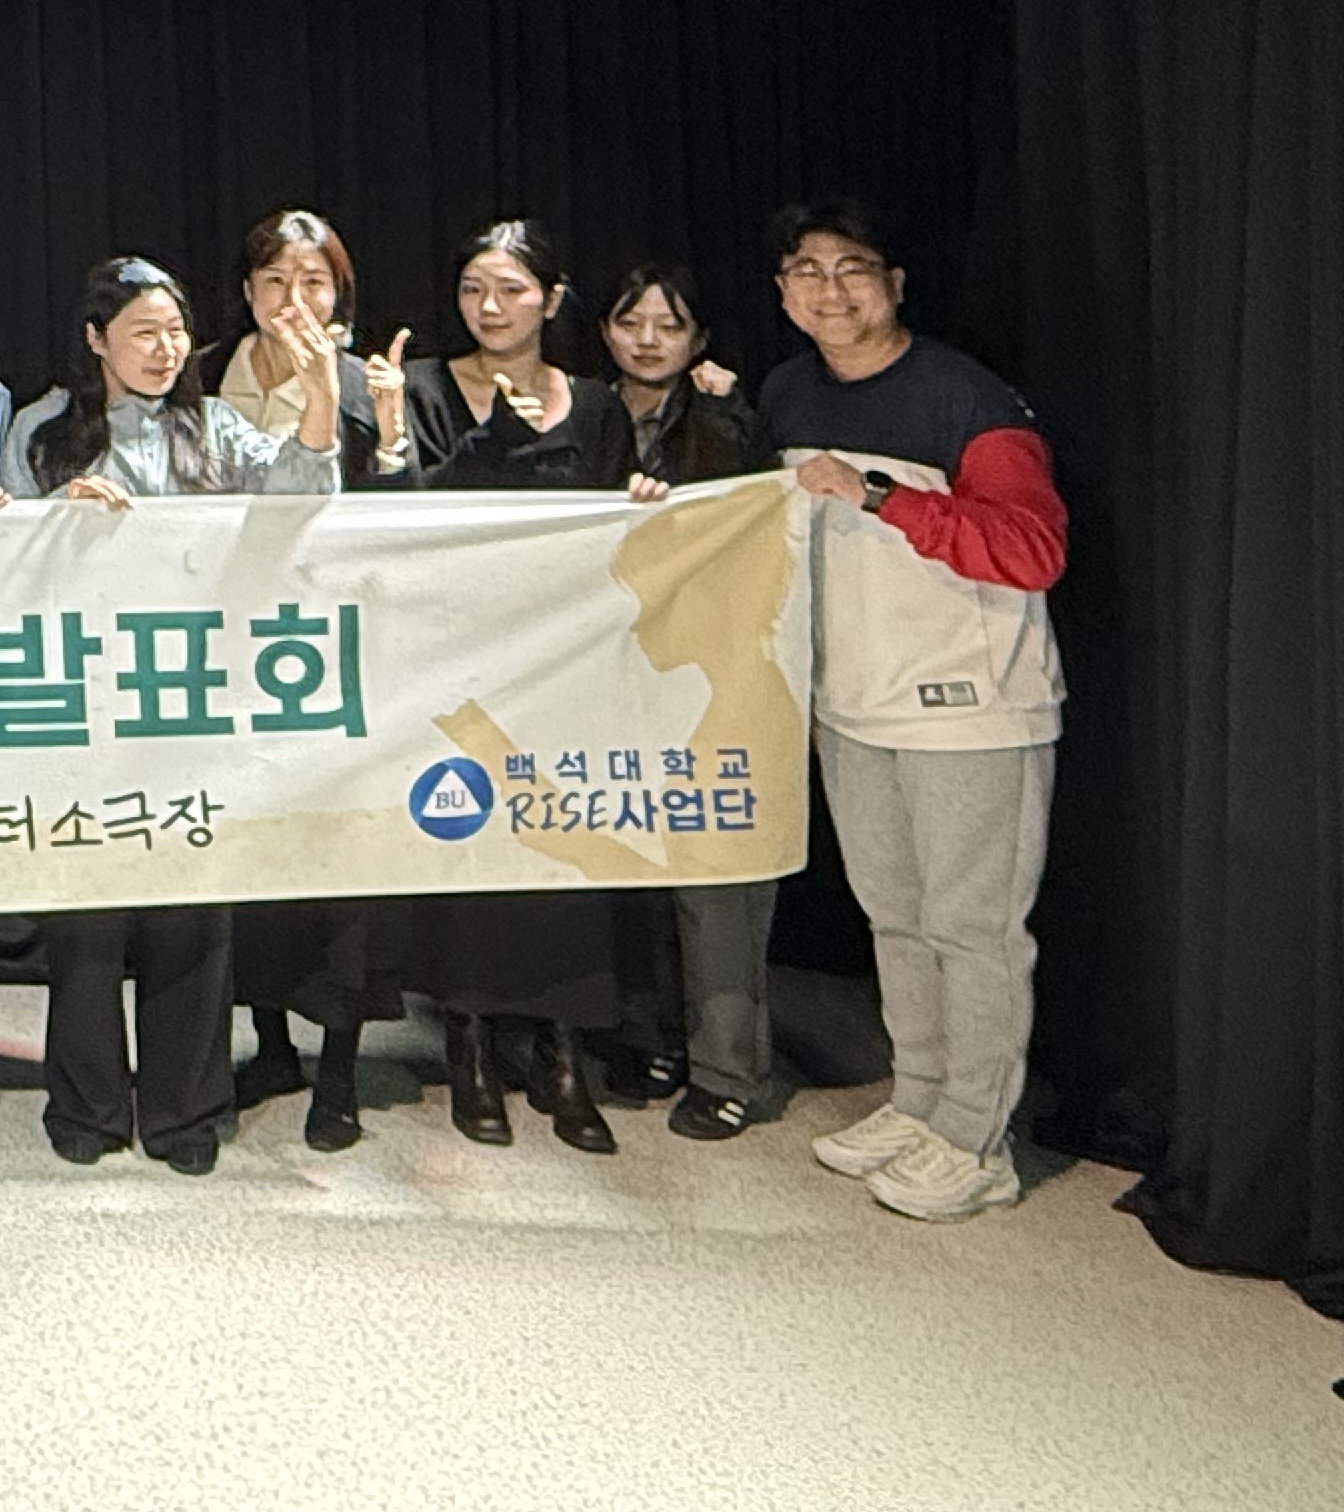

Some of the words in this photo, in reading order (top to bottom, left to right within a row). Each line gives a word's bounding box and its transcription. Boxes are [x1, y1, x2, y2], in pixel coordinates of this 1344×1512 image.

[50, 789, 225, 850] 소극장
[434, 790, 466, 810] BU
[505, 787, 758, 833] RISE사업단
